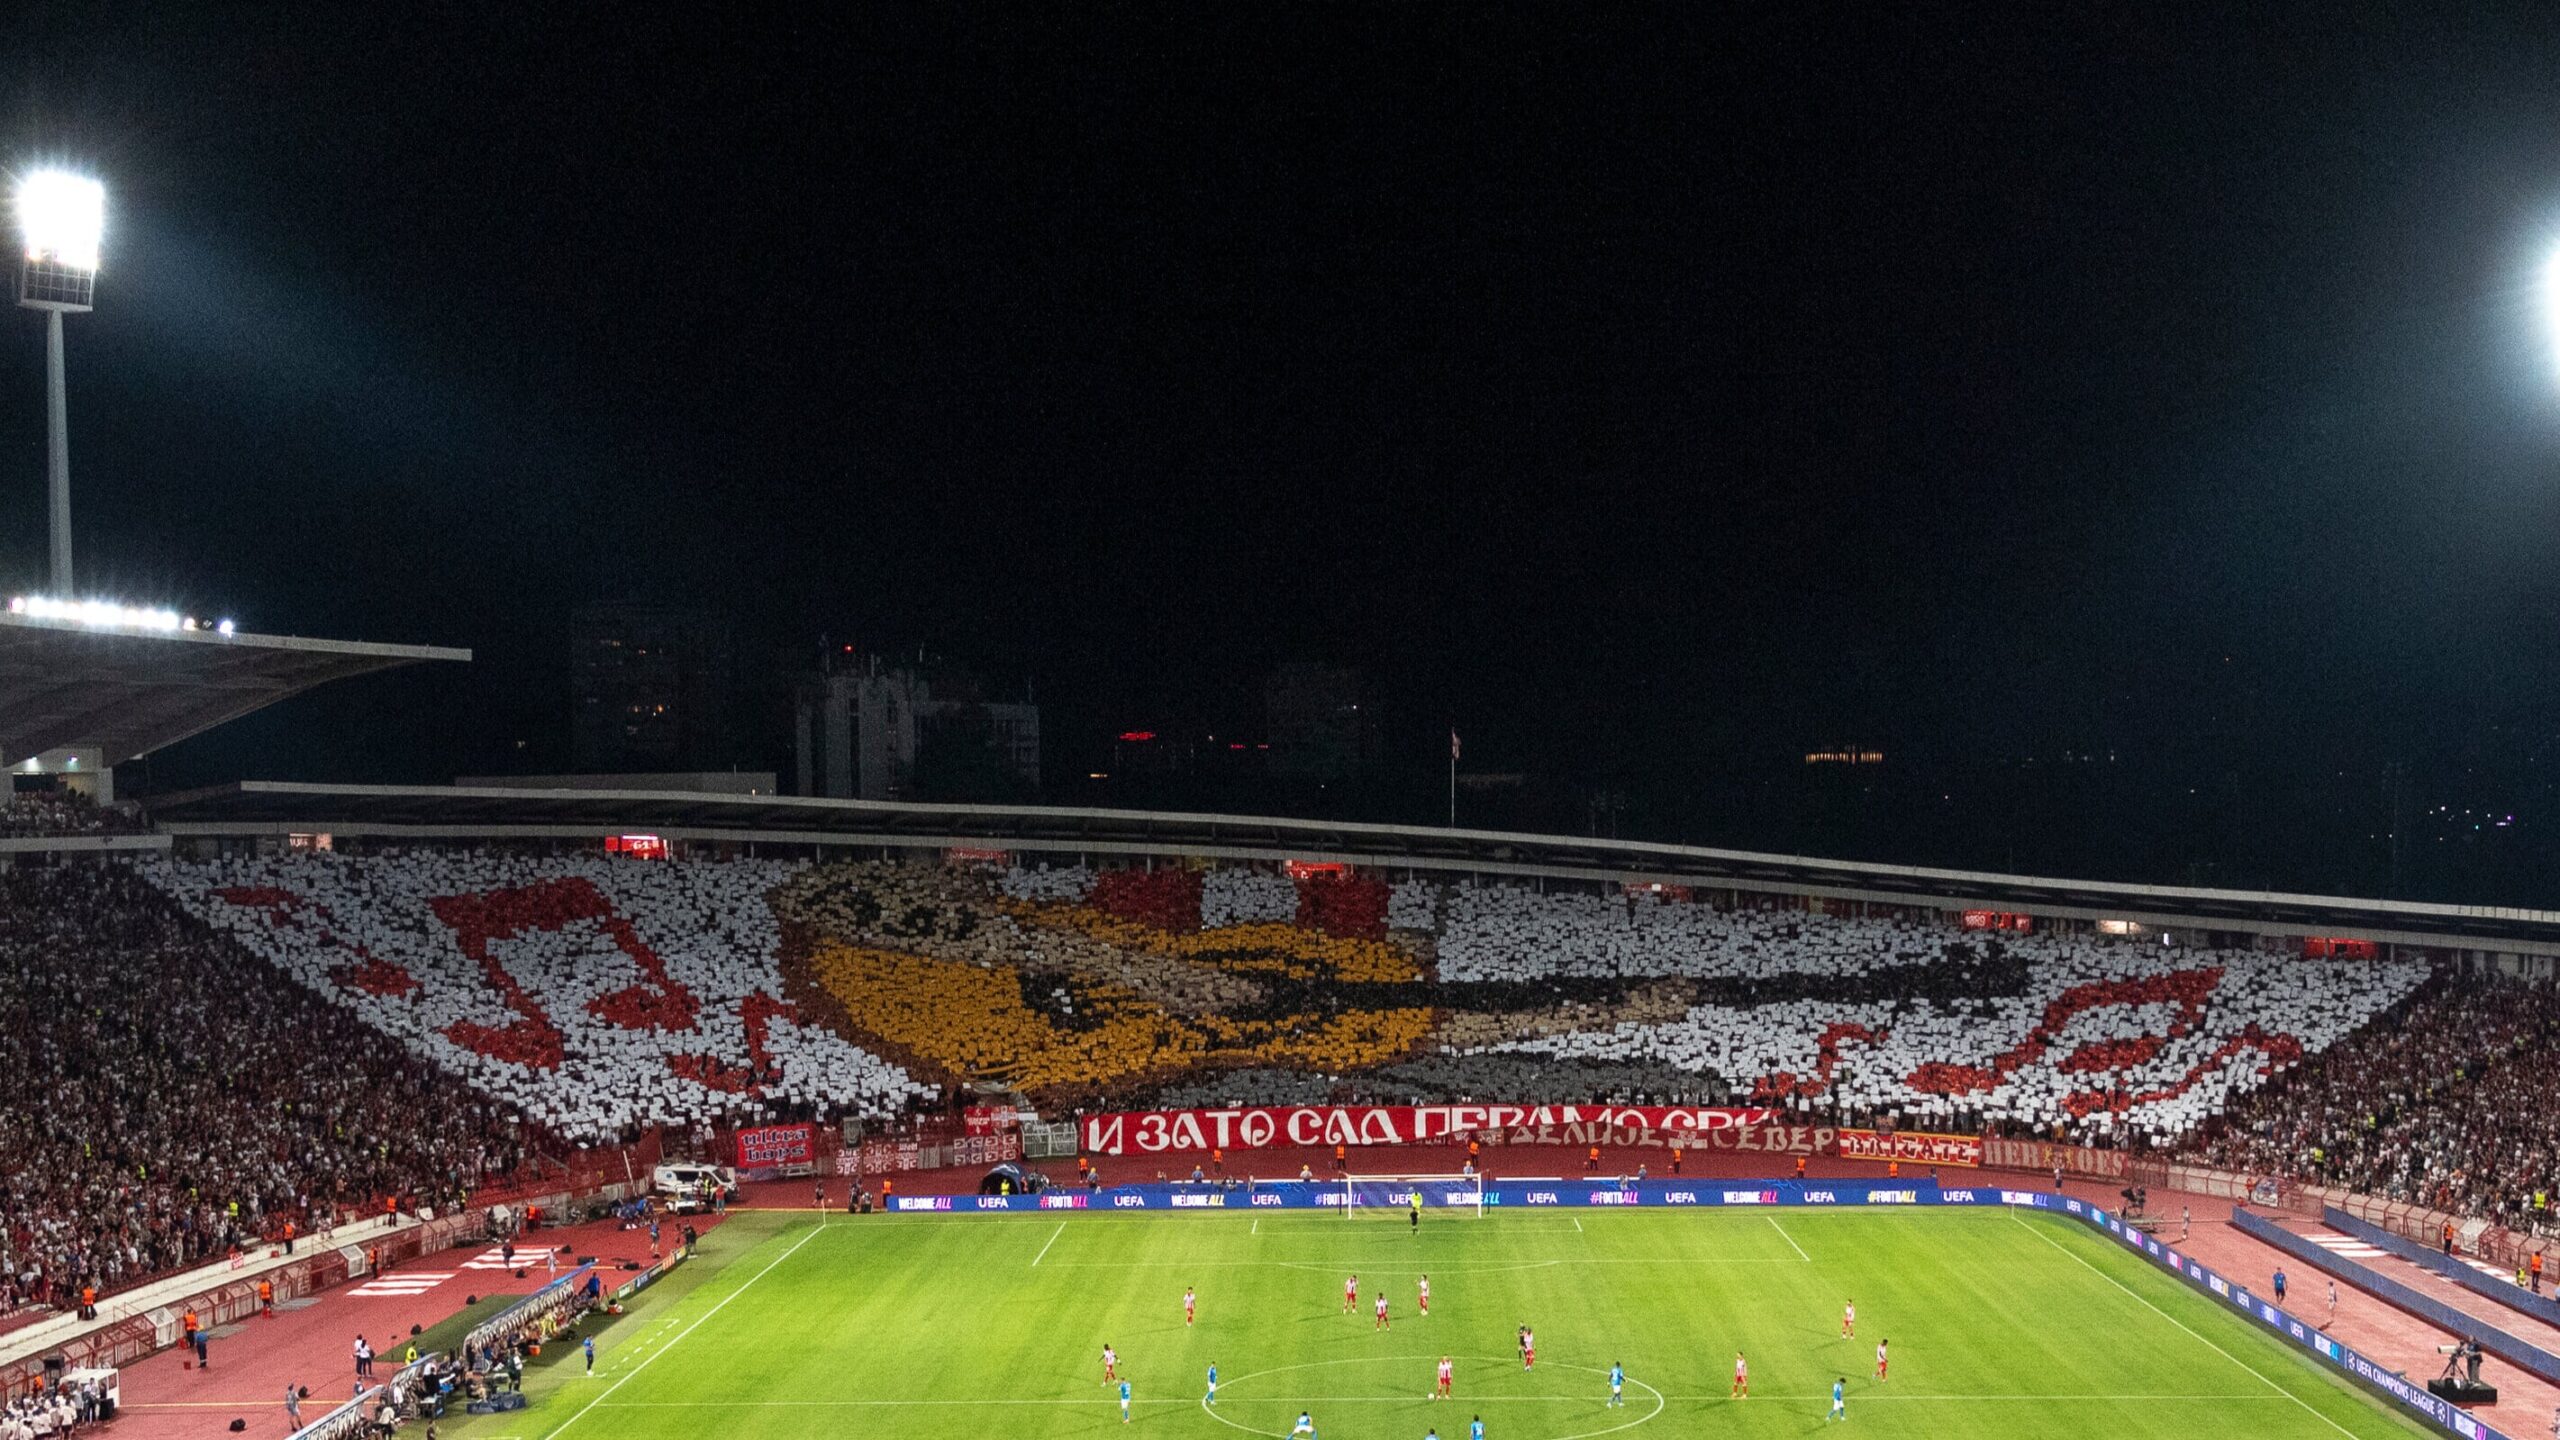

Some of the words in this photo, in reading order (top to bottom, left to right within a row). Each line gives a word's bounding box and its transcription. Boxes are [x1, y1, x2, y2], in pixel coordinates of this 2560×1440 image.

[742, 1128, 809, 1146] ultra
[1089, 1115, 1122, 1154] И
[1136, 1110, 1275, 1151] ЗАТО
[1288, 1109, 1402, 1145] САД
[1848, 1132, 1971, 1164] BRIGATE
[1040, 1195, 1088, 1208] #FOOTBALL
[1114, 1196, 1145, 1207] UEFA
[1251, 1194, 1282, 1206] UEFA
[1388, 1193, 1412, 1205] UEF
[1527, 1192, 1558, 1204] UEFA
[1590, 1191, 1639, 1204] #FOOTBALL
[1665, 1192, 1696, 1203] UEFA
[1804, 1191, 1836, 1203] UEFA
[1867, 1190, 1917, 1203] #FOOTBALL
[1943, 1190, 1975, 1202] UEFA
[978, 1197, 1009, 1209] UEFA
[2066, 1199, 2081, 1213] UEFA
[2356, 1358, 2373, 1380] UEFA
[2372, 1366, 2409, 1401] CHAMPIONS
[2409, 1388, 2436, 1416] LEAGUE
